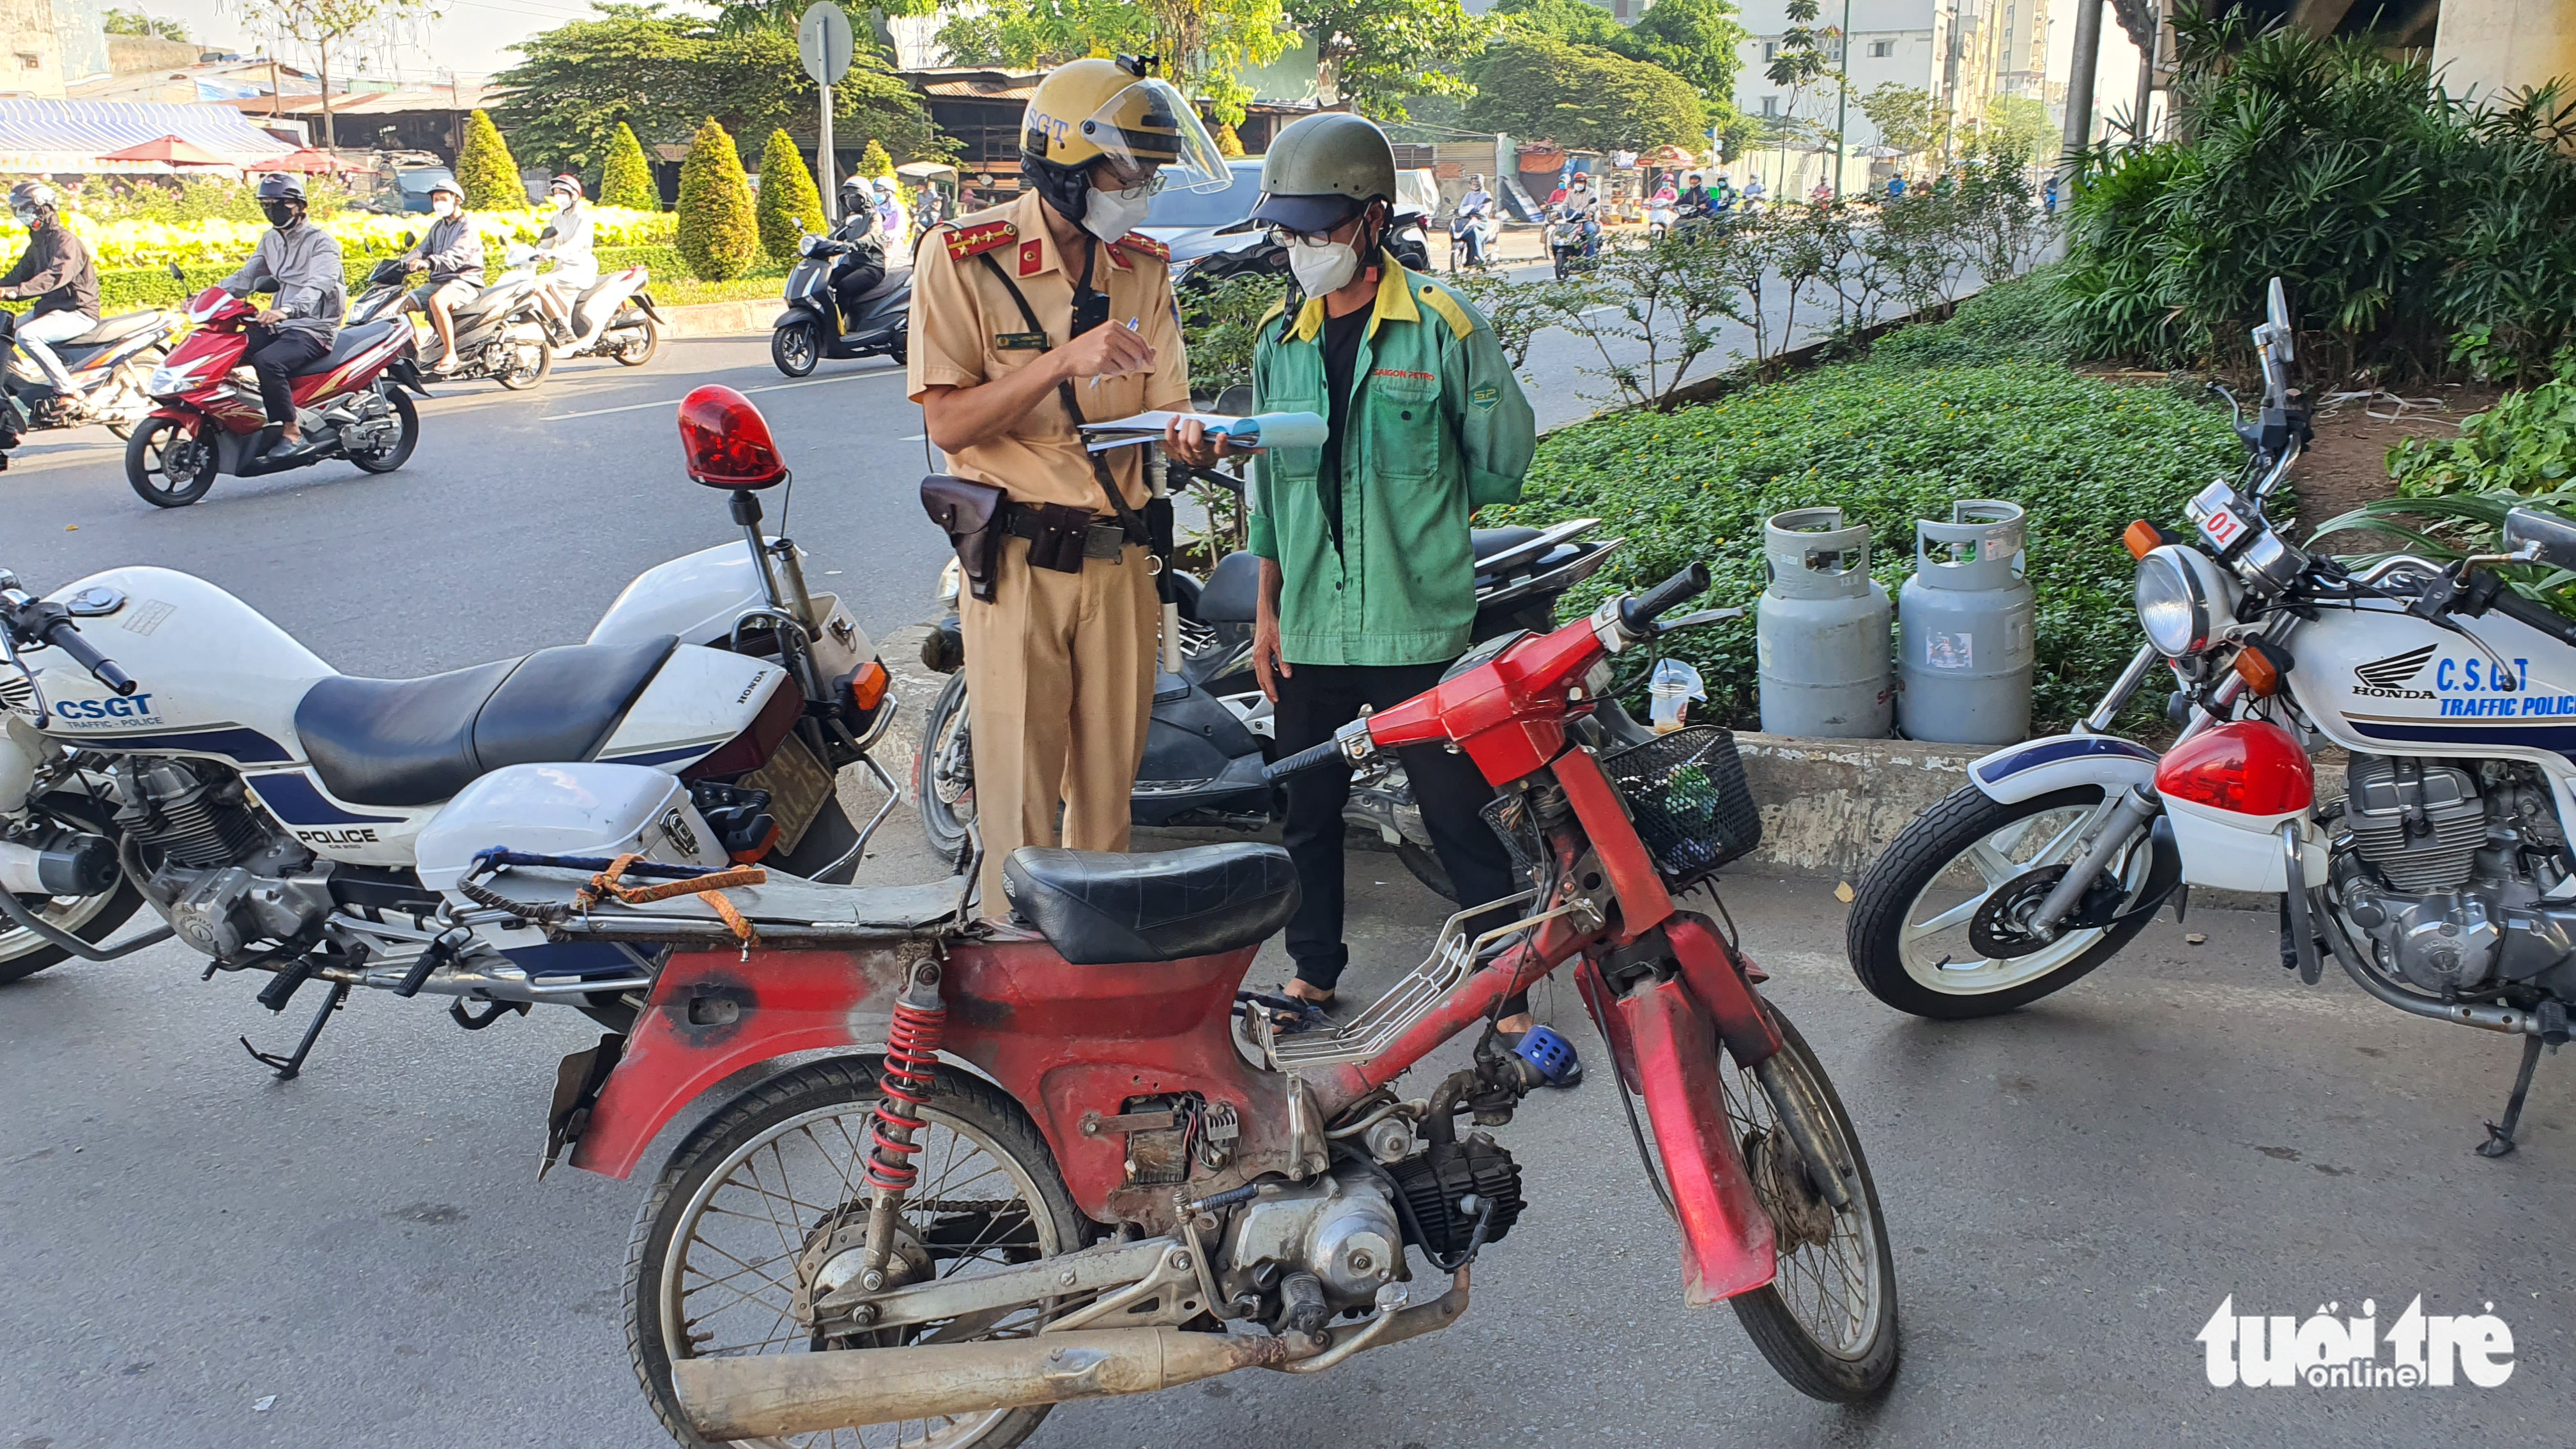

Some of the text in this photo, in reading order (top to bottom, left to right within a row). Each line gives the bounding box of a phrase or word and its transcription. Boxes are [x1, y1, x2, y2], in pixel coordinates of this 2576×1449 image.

[1028, 107, 1069, 144] SGT
[1373, 369, 1435, 381] SAIGON PETRO
[2207, 512, 2238, 543] 01
[737, 670, 768, 705] HONDA
[2352, 686, 2437, 700] HONDA
[56, 694, 152, 719] CSGT
[2440, 695, 2576, 716] TRAFFIC POLIC
[65, 720, 112, 729] TRAFFIC
[122, 717, 164, 726] POLICE
[296, 829, 381, 843] POLICE
